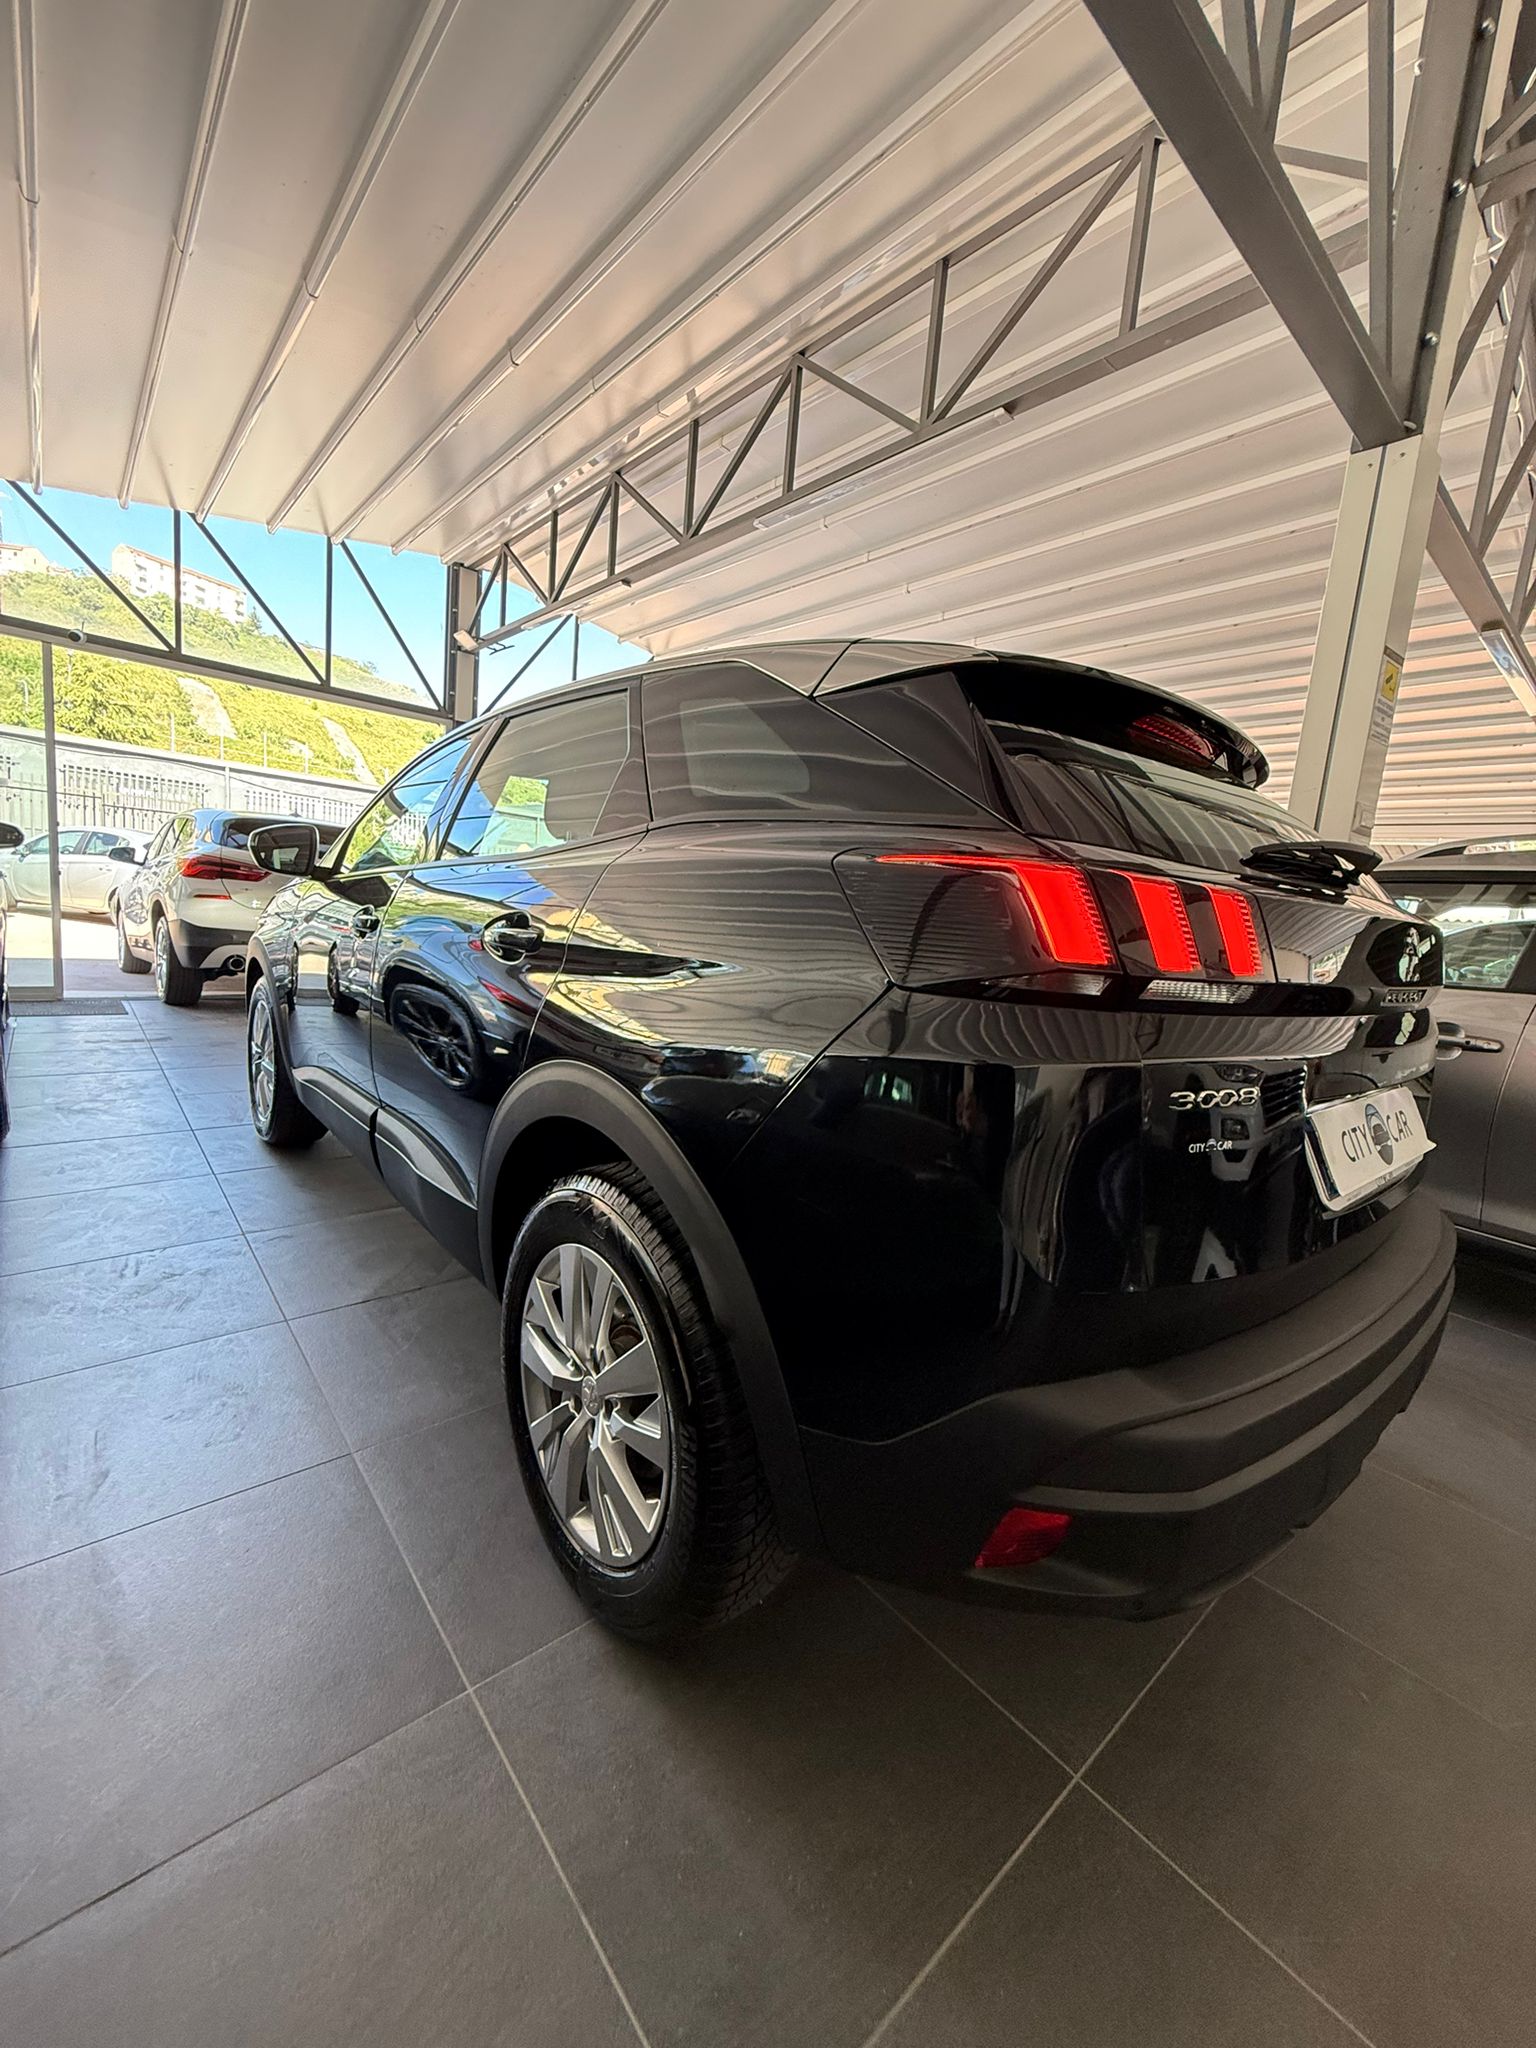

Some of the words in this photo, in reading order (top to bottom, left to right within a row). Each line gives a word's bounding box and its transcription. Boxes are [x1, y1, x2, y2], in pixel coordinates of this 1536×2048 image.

[1169, 1087, 1260, 1110] 3008
[1188, 1143, 1206, 1153] CITY
[1216, 1140, 1233, 1151] CAR
[1341, 1123, 1373, 1163] CITY
[1386, 1110, 1413, 1142] CAR
